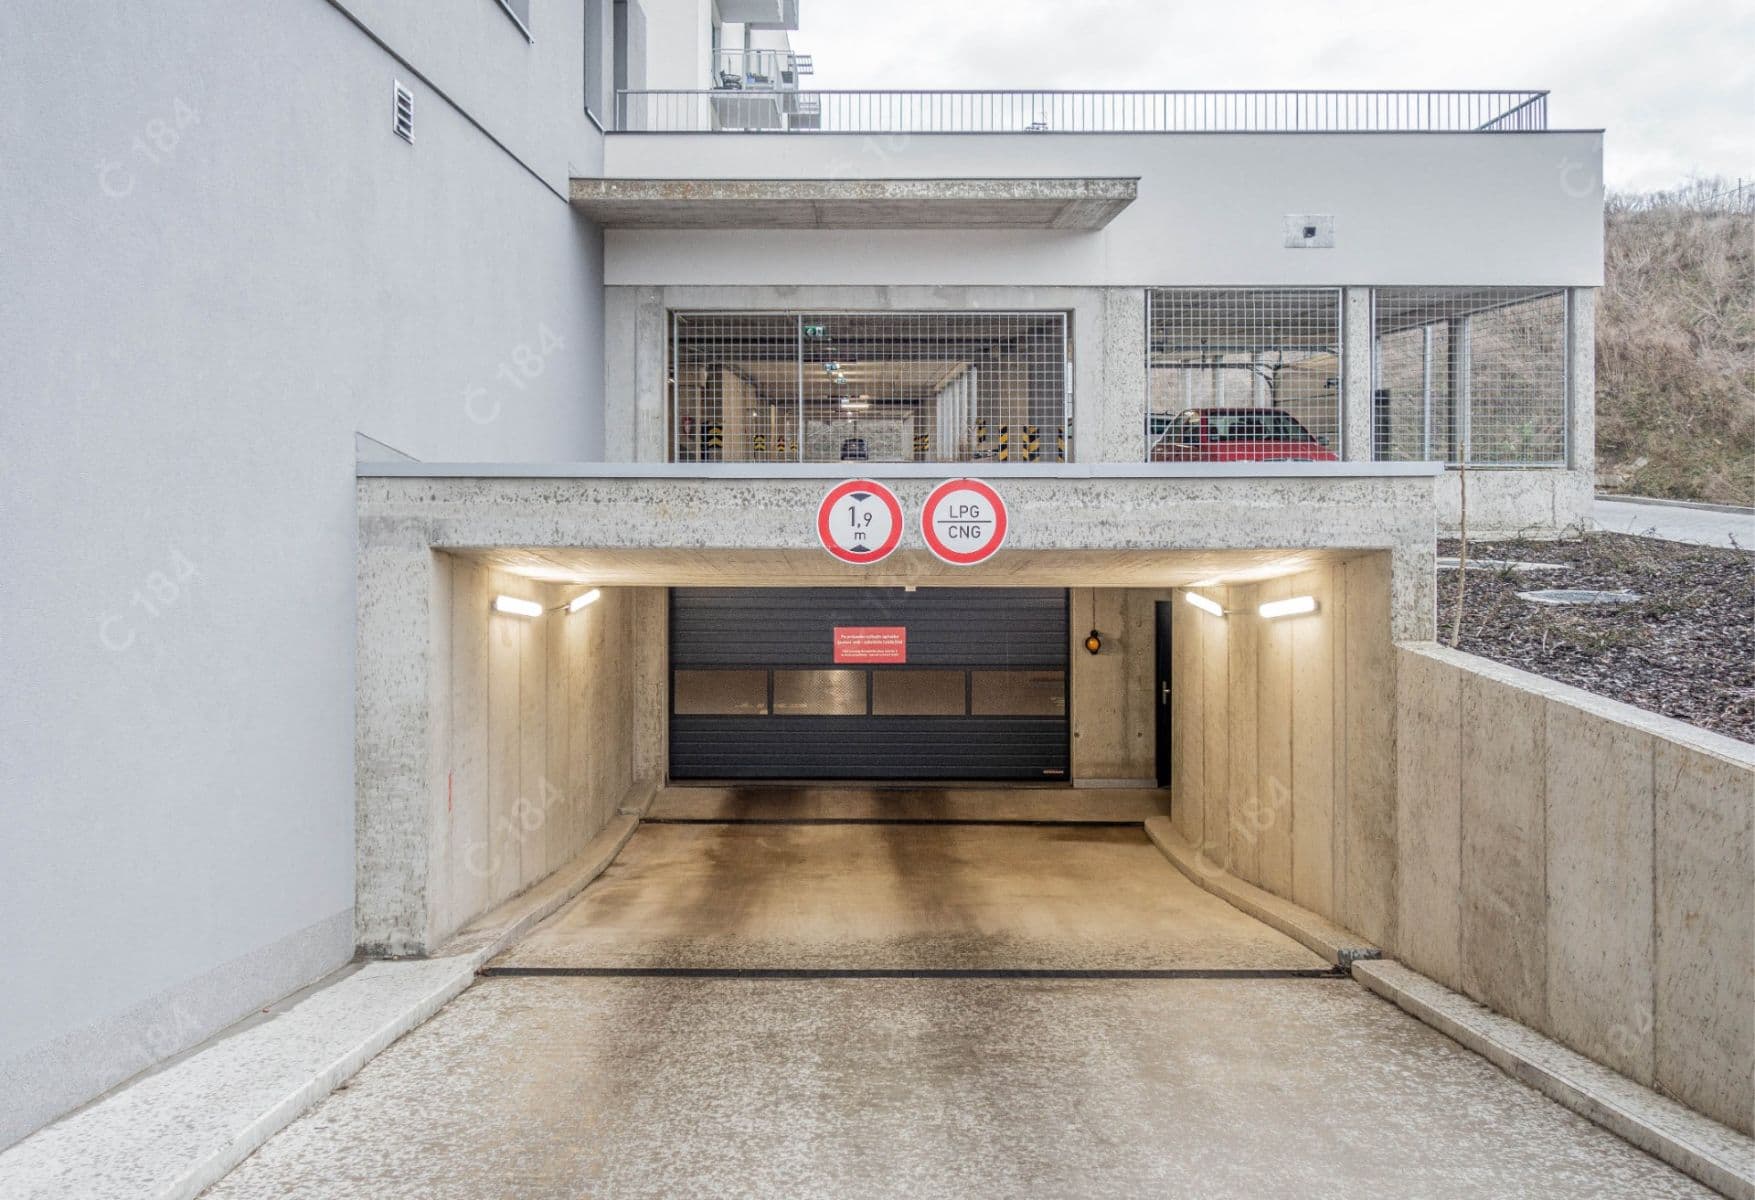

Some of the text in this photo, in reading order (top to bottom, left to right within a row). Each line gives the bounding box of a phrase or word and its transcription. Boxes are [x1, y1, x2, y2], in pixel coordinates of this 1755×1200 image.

[848, 506, 873, 528] 1,9
[951, 505, 980, 518] LPG
[854, 532, 866, 540] m
[948, 525, 982, 538] CNG
